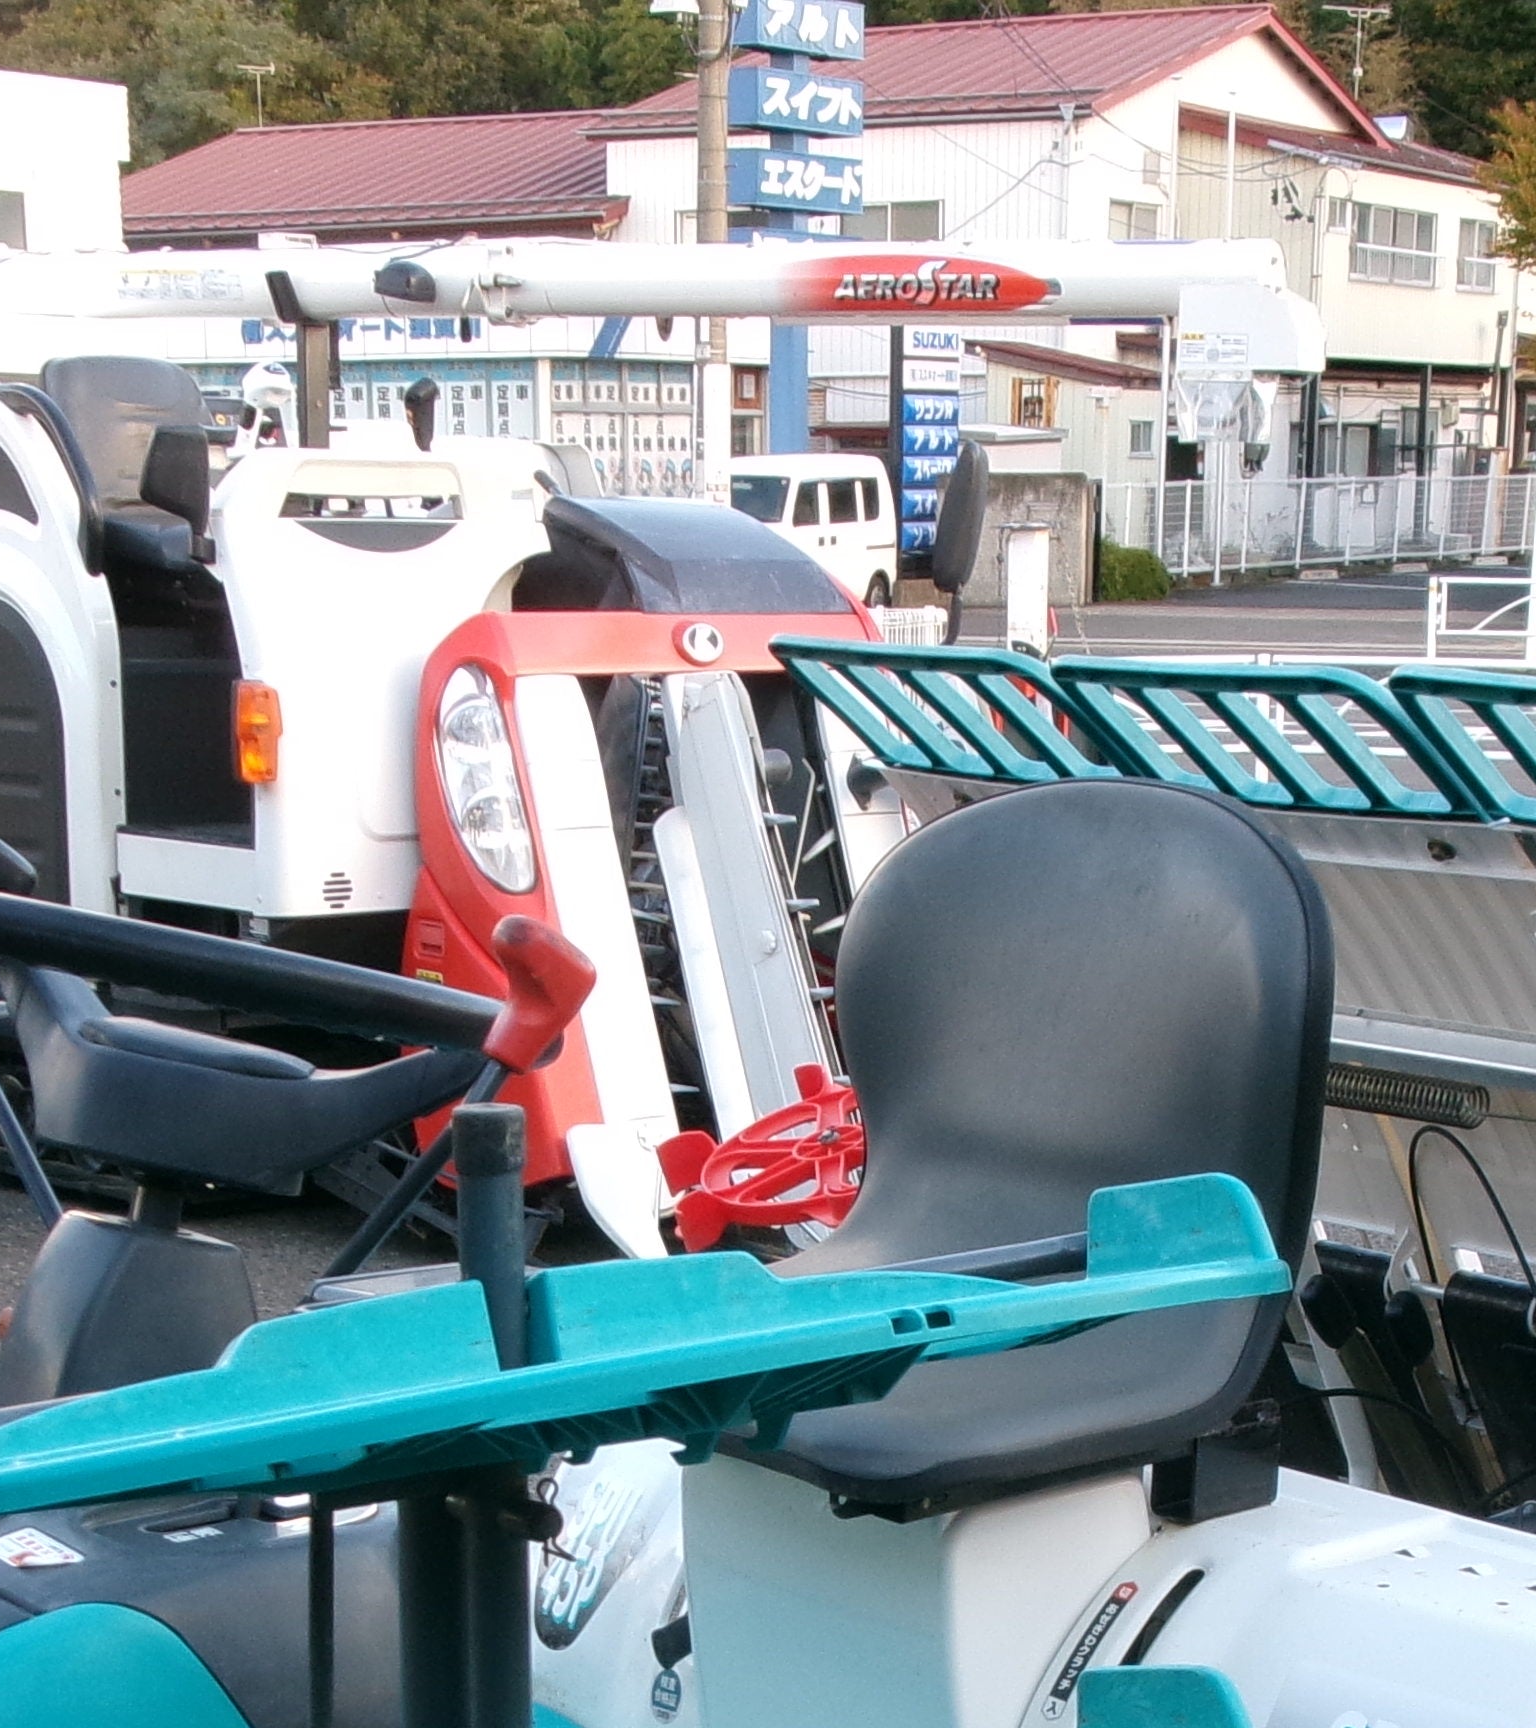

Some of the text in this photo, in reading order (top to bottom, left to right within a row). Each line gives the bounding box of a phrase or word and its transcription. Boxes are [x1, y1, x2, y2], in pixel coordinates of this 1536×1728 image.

[765, 0, 860, 49] アルト
[763, 76, 862, 126] スイフト
[760, 158, 864, 205] エスクード
[833, 259, 999, 306] AEROSTAR
[912, 331, 959, 351] SUZUKI
